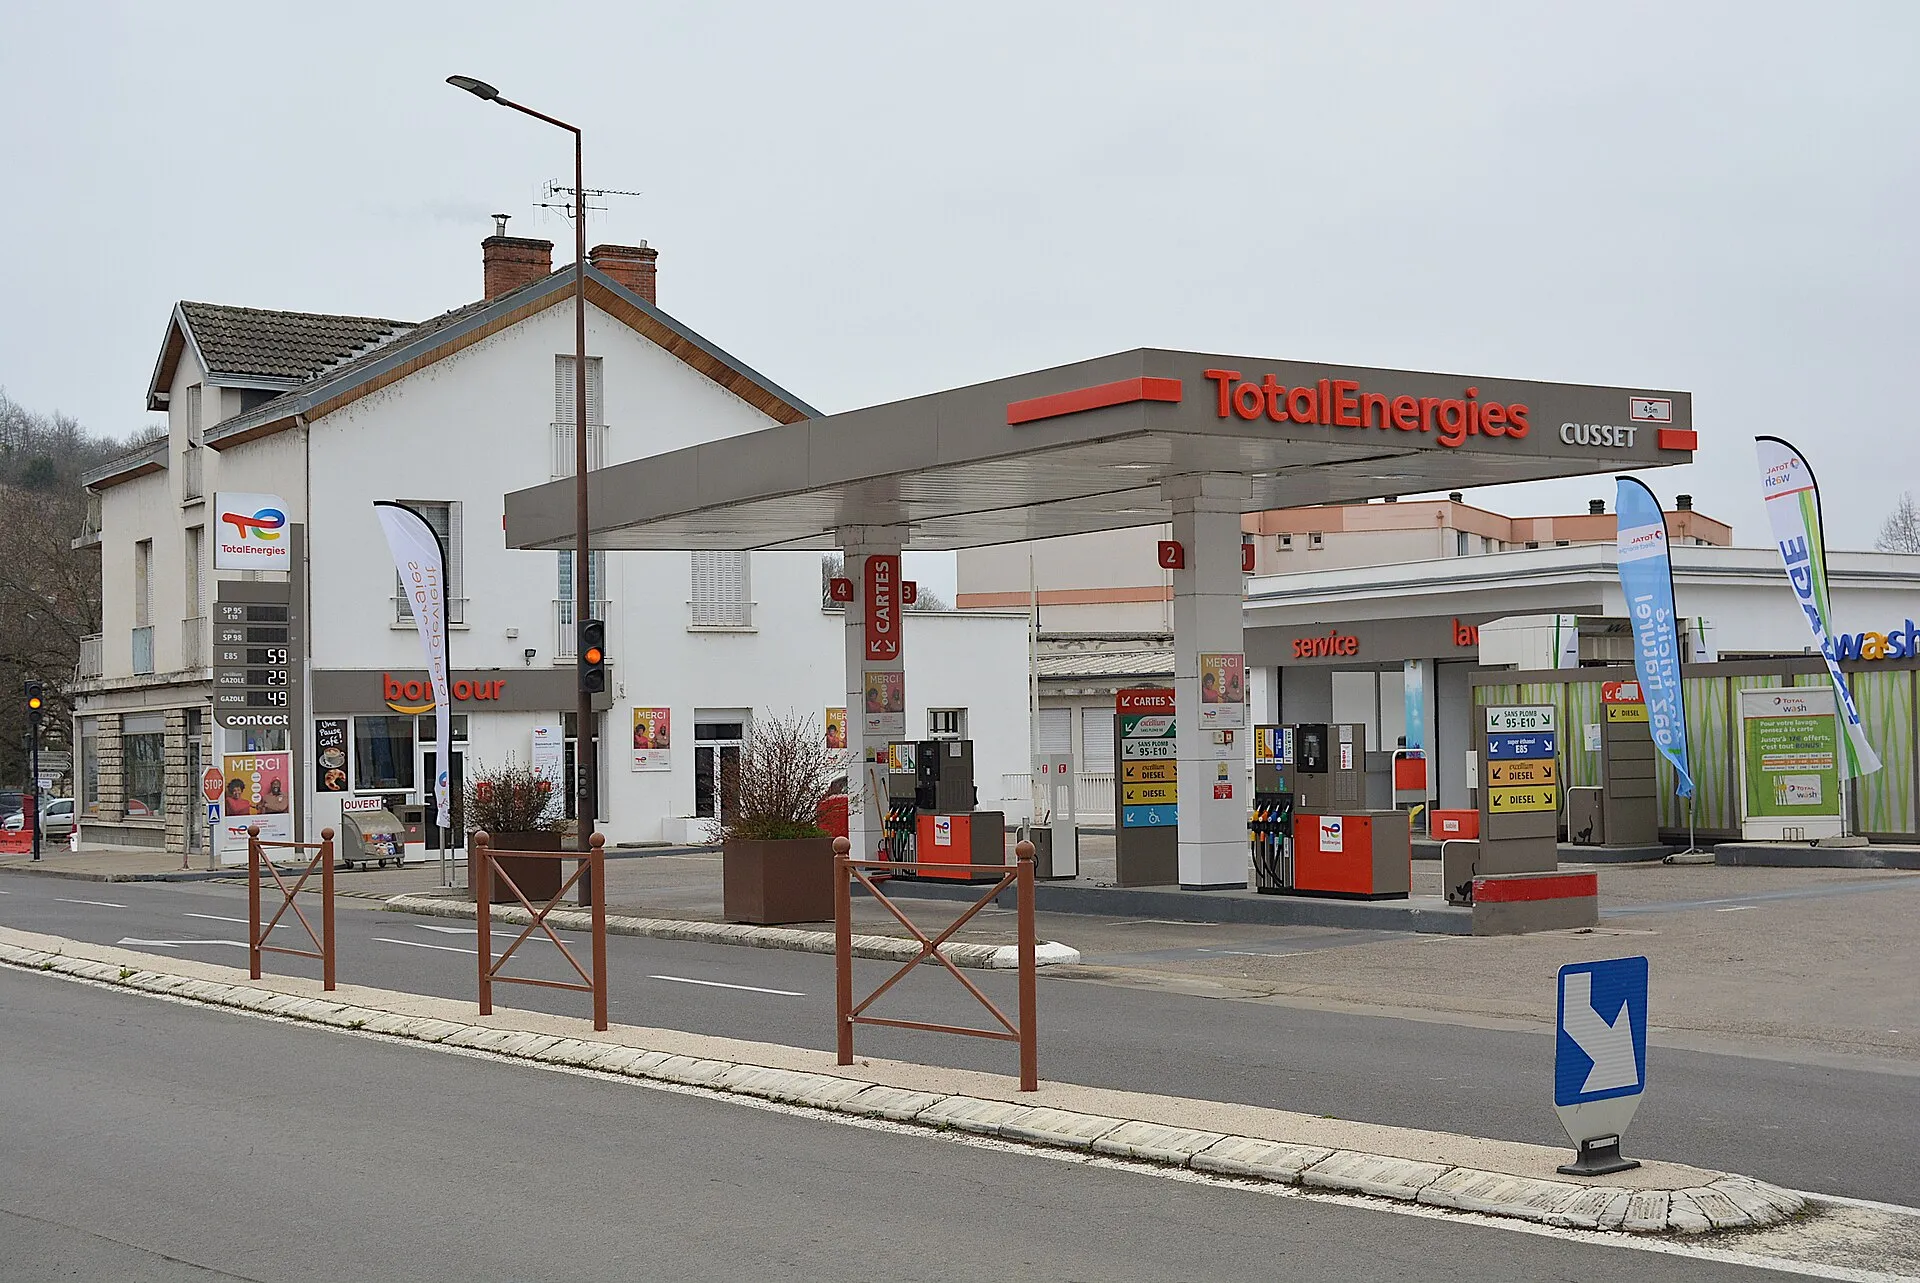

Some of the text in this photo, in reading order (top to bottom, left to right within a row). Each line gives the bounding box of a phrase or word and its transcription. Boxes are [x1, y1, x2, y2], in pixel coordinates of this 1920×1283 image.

[1204, 368, 1530, 448] TotalEnergies
[1560, 422, 1637, 448] CUSSET
[221, 544, 286, 557] TotalEnergies
[1166, 546, 1176, 563] 2
[836, 583, 846, 597] 4
[904, 586, 911, 599] 3
[875, 561, 891, 634] CARTES
[1292, 630, 1359, 659] service
[1833, 618, 1920, 661] wash
[224, 652, 238, 660] E85
[267, 649, 287, 664] 59
[1206, 658, 1238, 668] MERCI
[268, 670, 287, 685] 29
[870, 675, 899, 684] MERCI
[383, 671, 507, 701] boour
[268, 691, 287, 706] 49
[1134, 696, 1166, 706] CARTES
[1783, 704, 1807, 712] wash
[226, 714, 289, 725] contact
[638, 712, 666, 720] MERCI
[830, 712, 847, 720] MER
[1506, 718, 1536, 728] 95-E10
[1139, 747, 1168, 756] 95-E10
[1516, 744, 1528, 754] E85
[232, 758, 280, 772] MERCI
[1142, 770, 1165, 779] DIESEL
[1509, 771, 1534, 780] DIESEL
[204, 779, 223, 790] STOP
[1142, 790, 1166, 798] DIESEL
[1510, 794, 1536, 804] DIESEL
[344, 799, 380, 810] OUVERT
